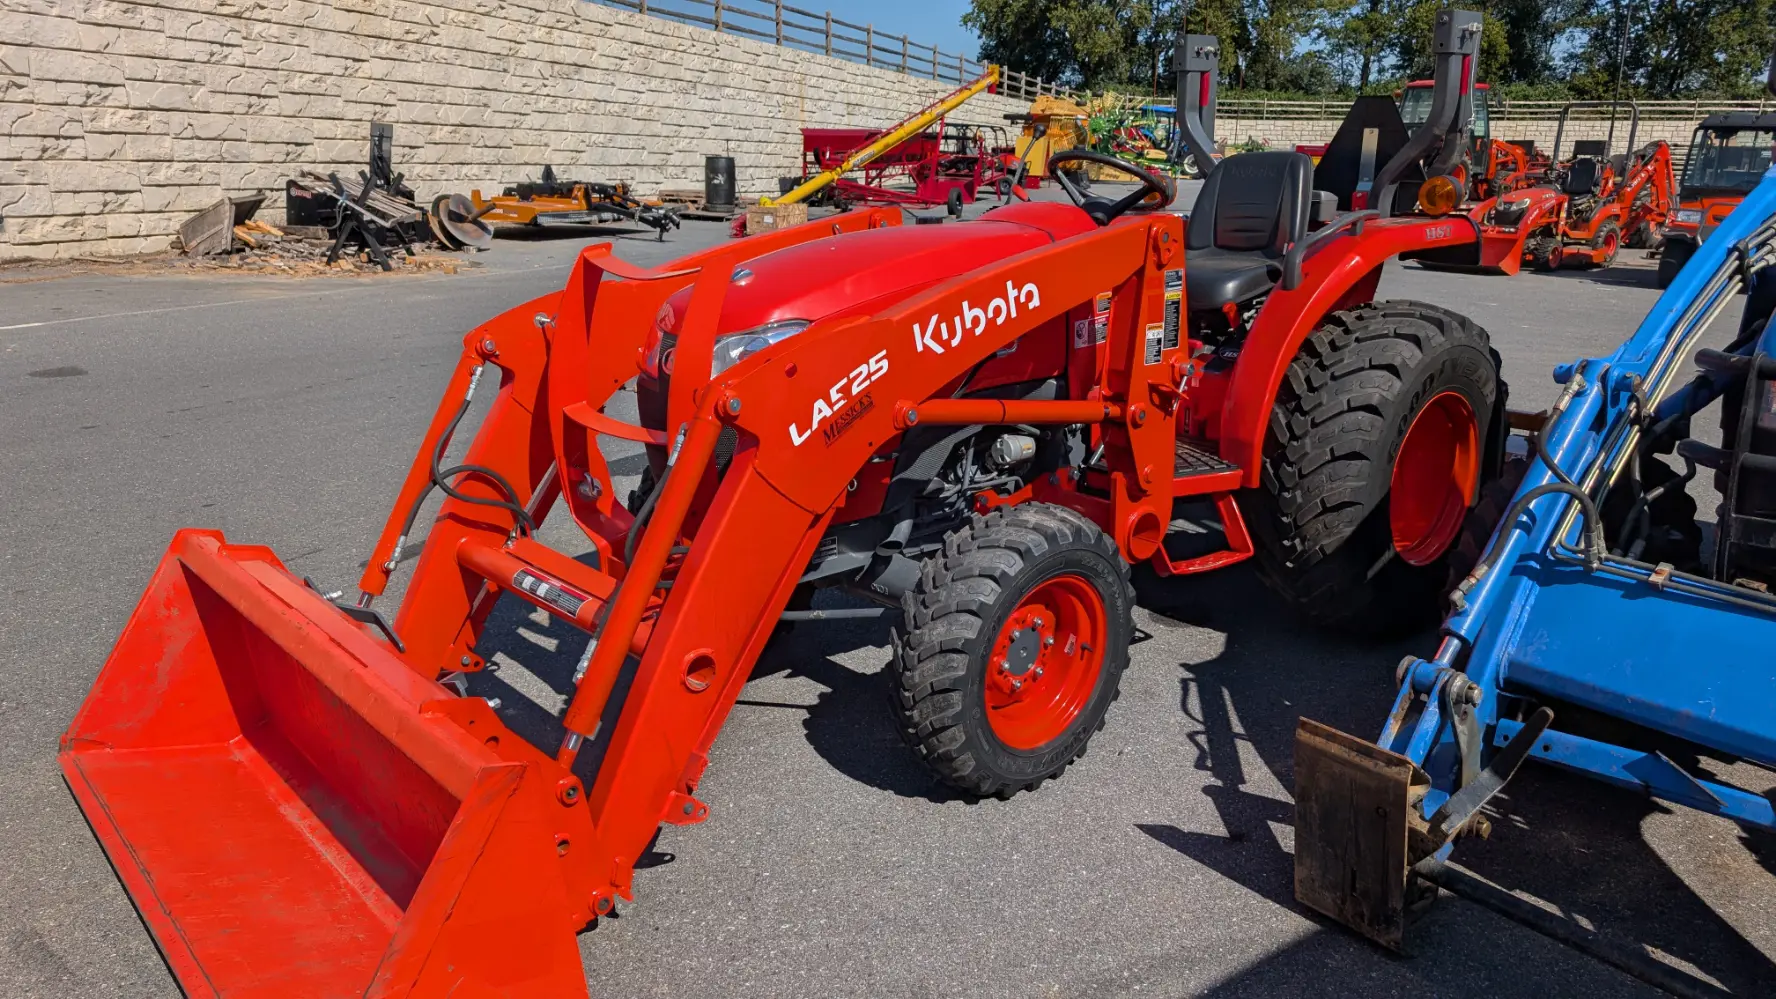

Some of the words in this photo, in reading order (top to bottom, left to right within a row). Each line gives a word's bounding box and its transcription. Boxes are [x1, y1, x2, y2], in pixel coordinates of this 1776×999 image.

[1425, 225, 1453, 240] HST
[912, 280, 1040, 354] Kubota
[788, 349, 889, 447] LA525
